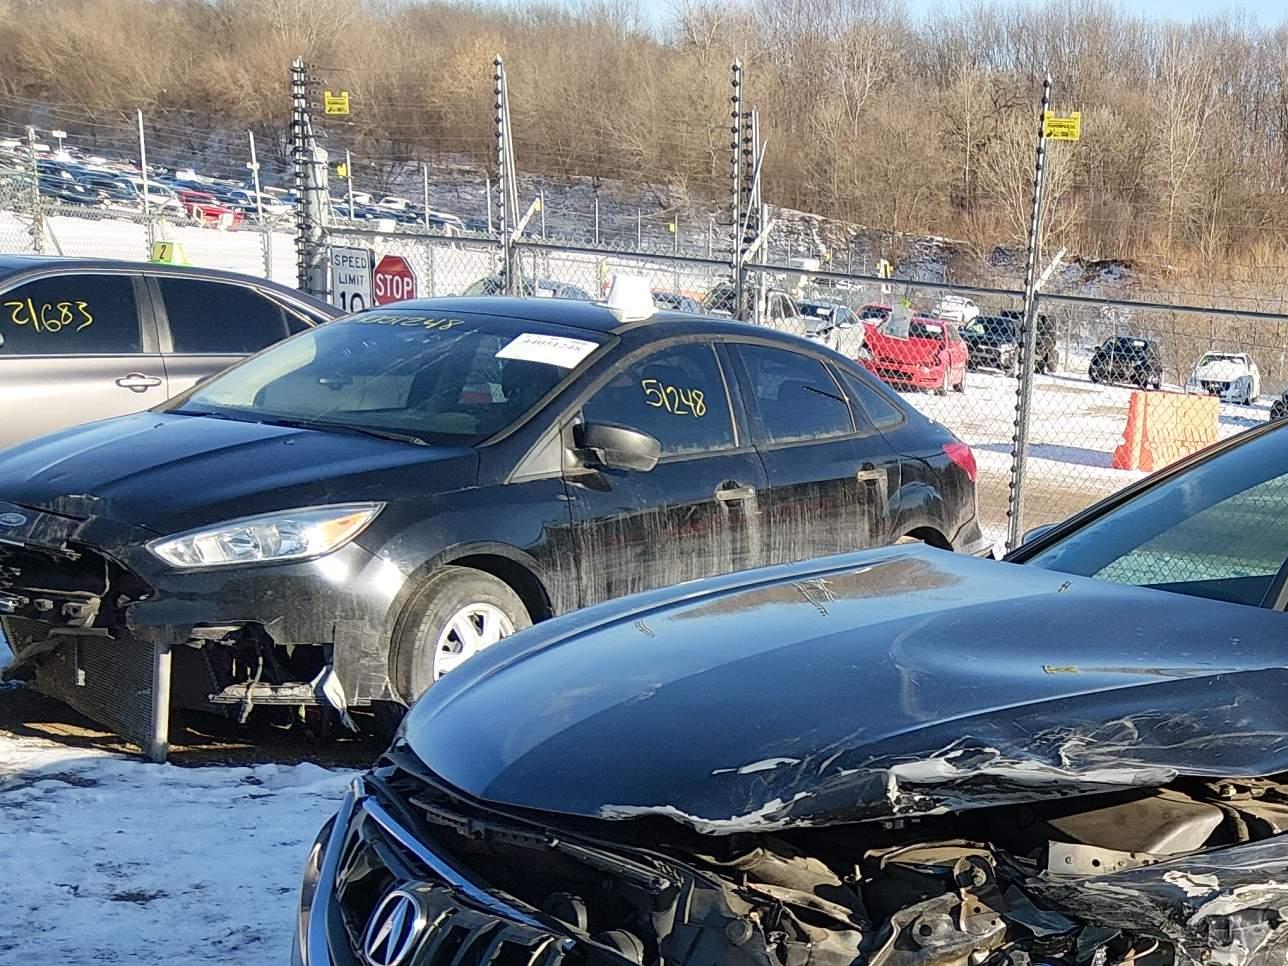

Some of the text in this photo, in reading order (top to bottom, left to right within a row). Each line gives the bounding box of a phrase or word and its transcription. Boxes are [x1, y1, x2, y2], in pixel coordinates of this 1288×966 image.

[159, 244, 167, 260] 2
[334, 254, 367, 269] SPEED
[338, 272, 364, 286] LIMIT
[375, 273, 413, 300] STOP
[339, 291, 366, 313] 10
[4, 298, 94, 333] 21683
[641, 379, 707, 418] 51248
